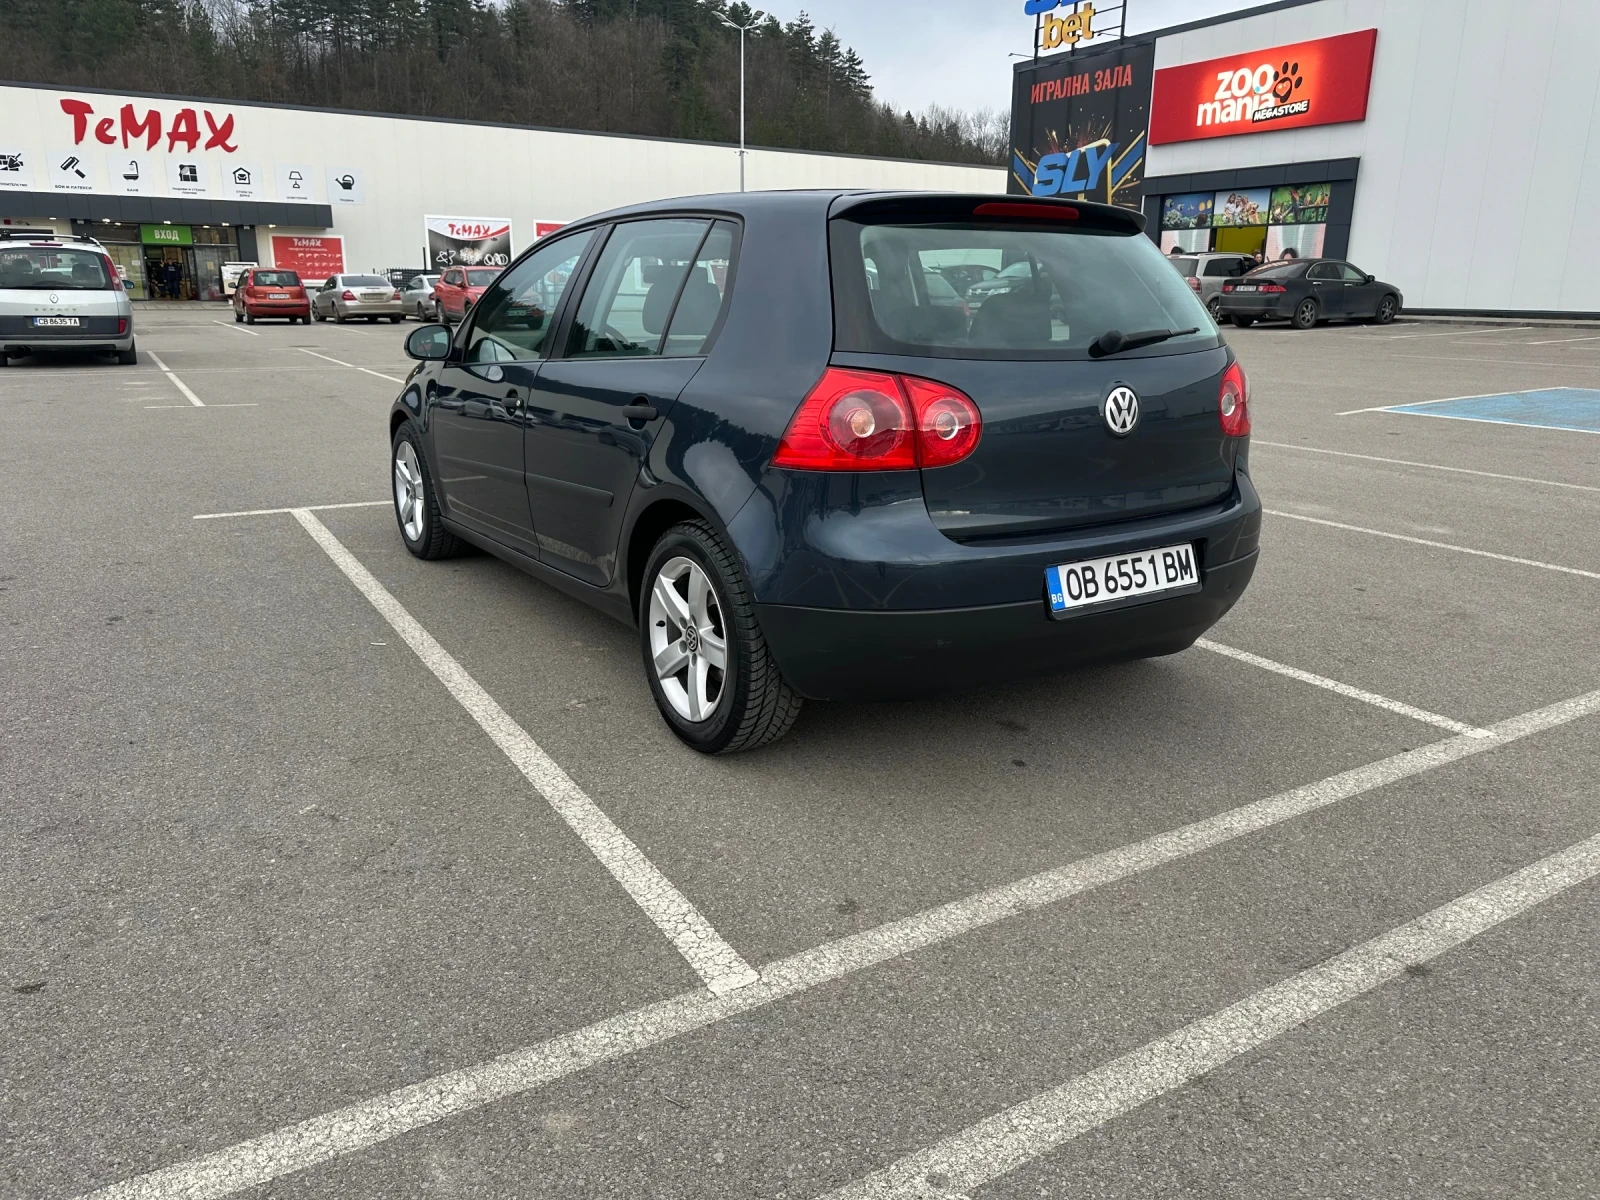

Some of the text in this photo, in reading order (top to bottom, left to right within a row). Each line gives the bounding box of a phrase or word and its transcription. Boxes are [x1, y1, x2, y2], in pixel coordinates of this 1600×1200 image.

[1043, 2, 1096, 50] bet
[1031, 64, 1132, 104] ИГРАЛНА ЗАЛА
[60, 98, 238, 153] TeMAX
[1253, 100, 1309, 121] MEGASTORE
[1032, 142, 1120, 197] SLY
[154, 229, 180, 241] ВХОД
[1104, 554, 1159, 594] 6551
[1162, 548, 1194, 583] BM
[1051, 594, 1063, 604] BG
